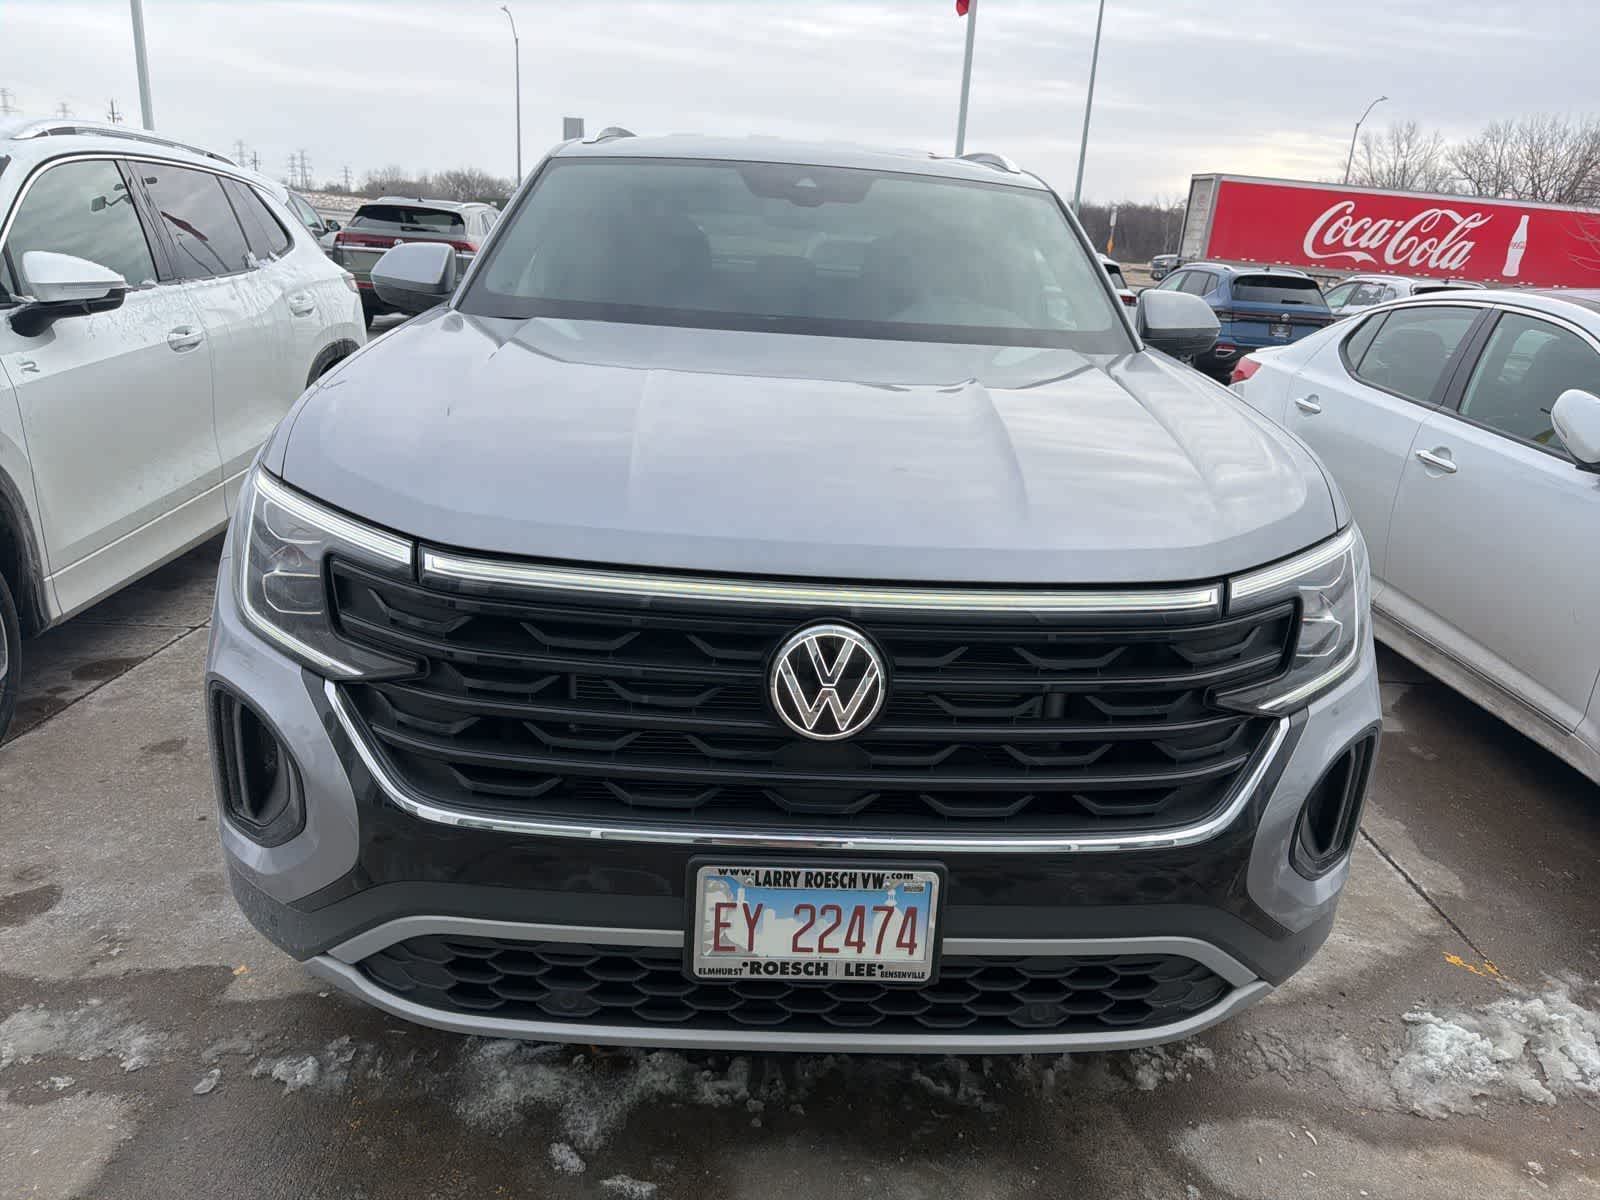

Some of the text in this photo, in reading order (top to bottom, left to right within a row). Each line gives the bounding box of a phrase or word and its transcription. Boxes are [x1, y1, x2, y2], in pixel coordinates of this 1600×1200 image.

[1303, 200, 1494, 271] Coca-Cola
[777, 634, 880, 732] VW
[804, 871, 858, 889] ROESCH
[713, 902, 918, 955] EY 22474
[698, 968, 744, 976] ELMHURST
[880, 970, 926, 979] BENSENVILLE
